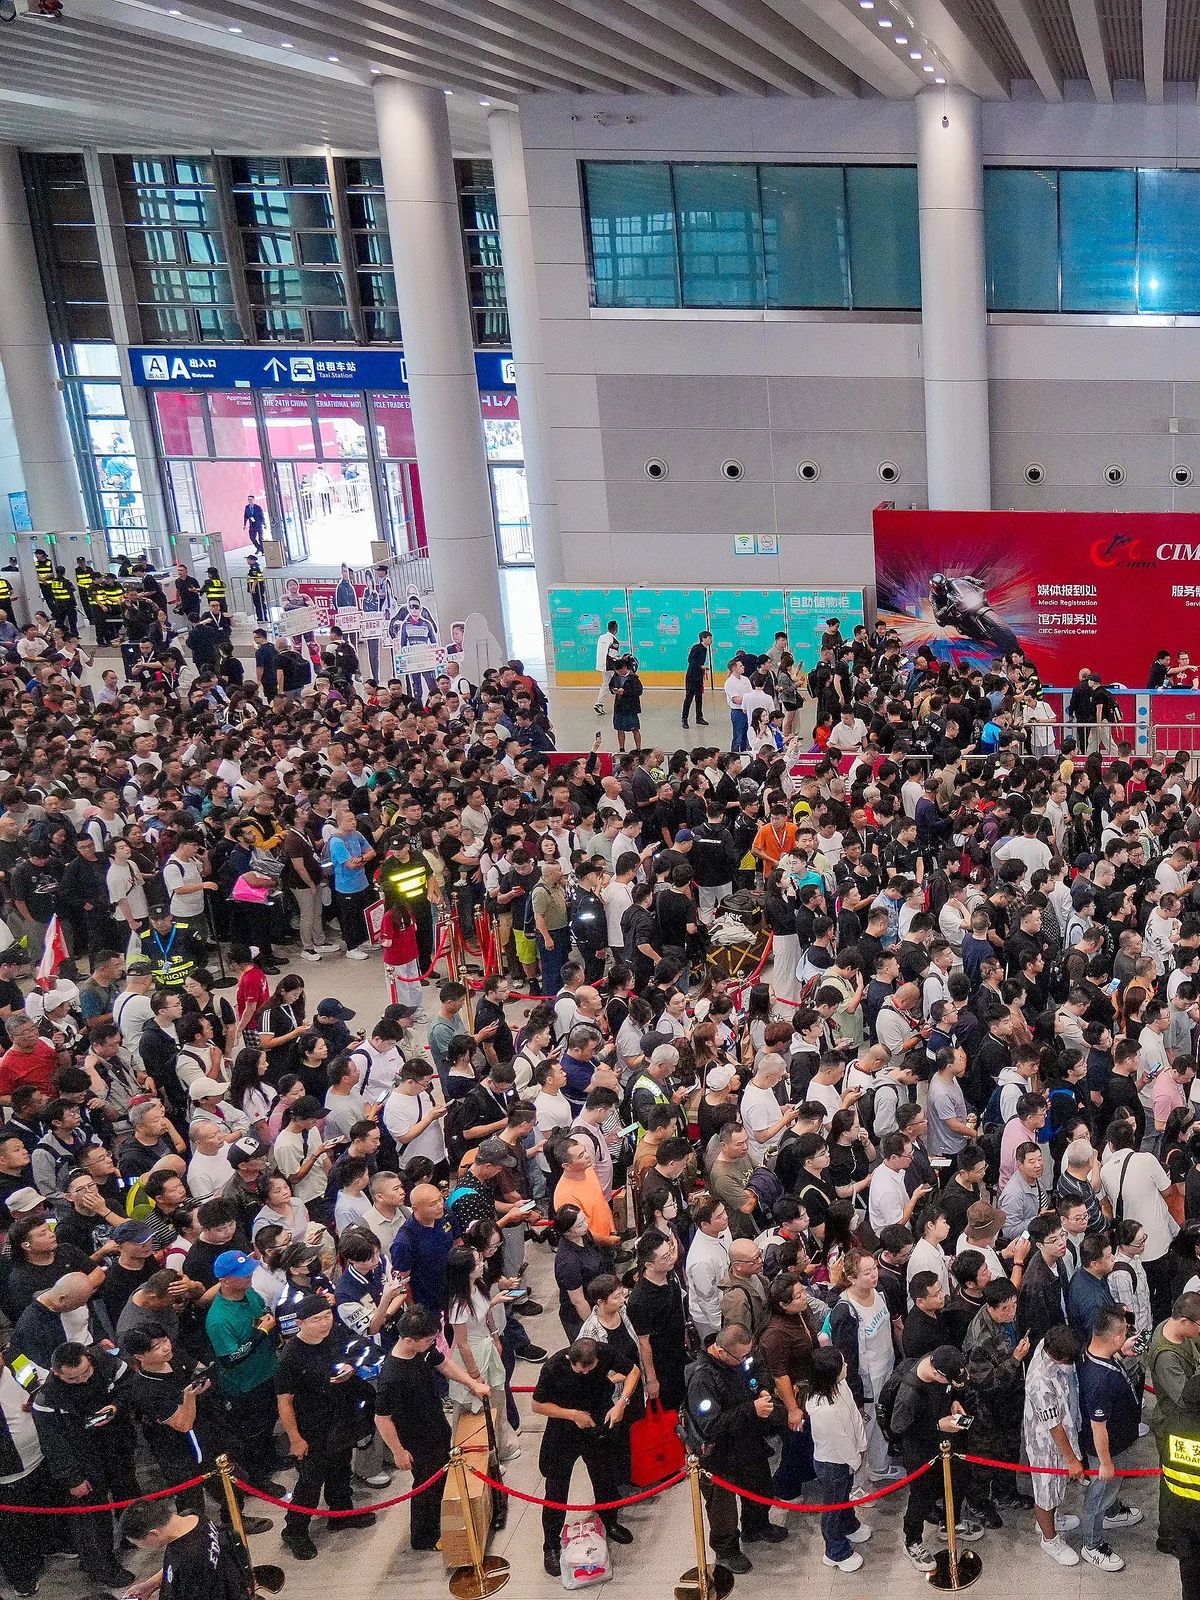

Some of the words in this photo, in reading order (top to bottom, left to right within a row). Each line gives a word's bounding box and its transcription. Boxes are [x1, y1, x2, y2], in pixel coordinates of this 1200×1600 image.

[150, 357, 163, 373] A
[170, 357, 192, 379] A
[189, 358, 217, 368] 出入口
[316, 361, 357, 372] 出租车站
[1037, 584, 1097, 597] 媒体报到处
[790, 596, 850, 608] 自助储物柜
[1060, 599, 1098, 607] Registration
[1037, 613, 1097, 626] 馆方服务处
